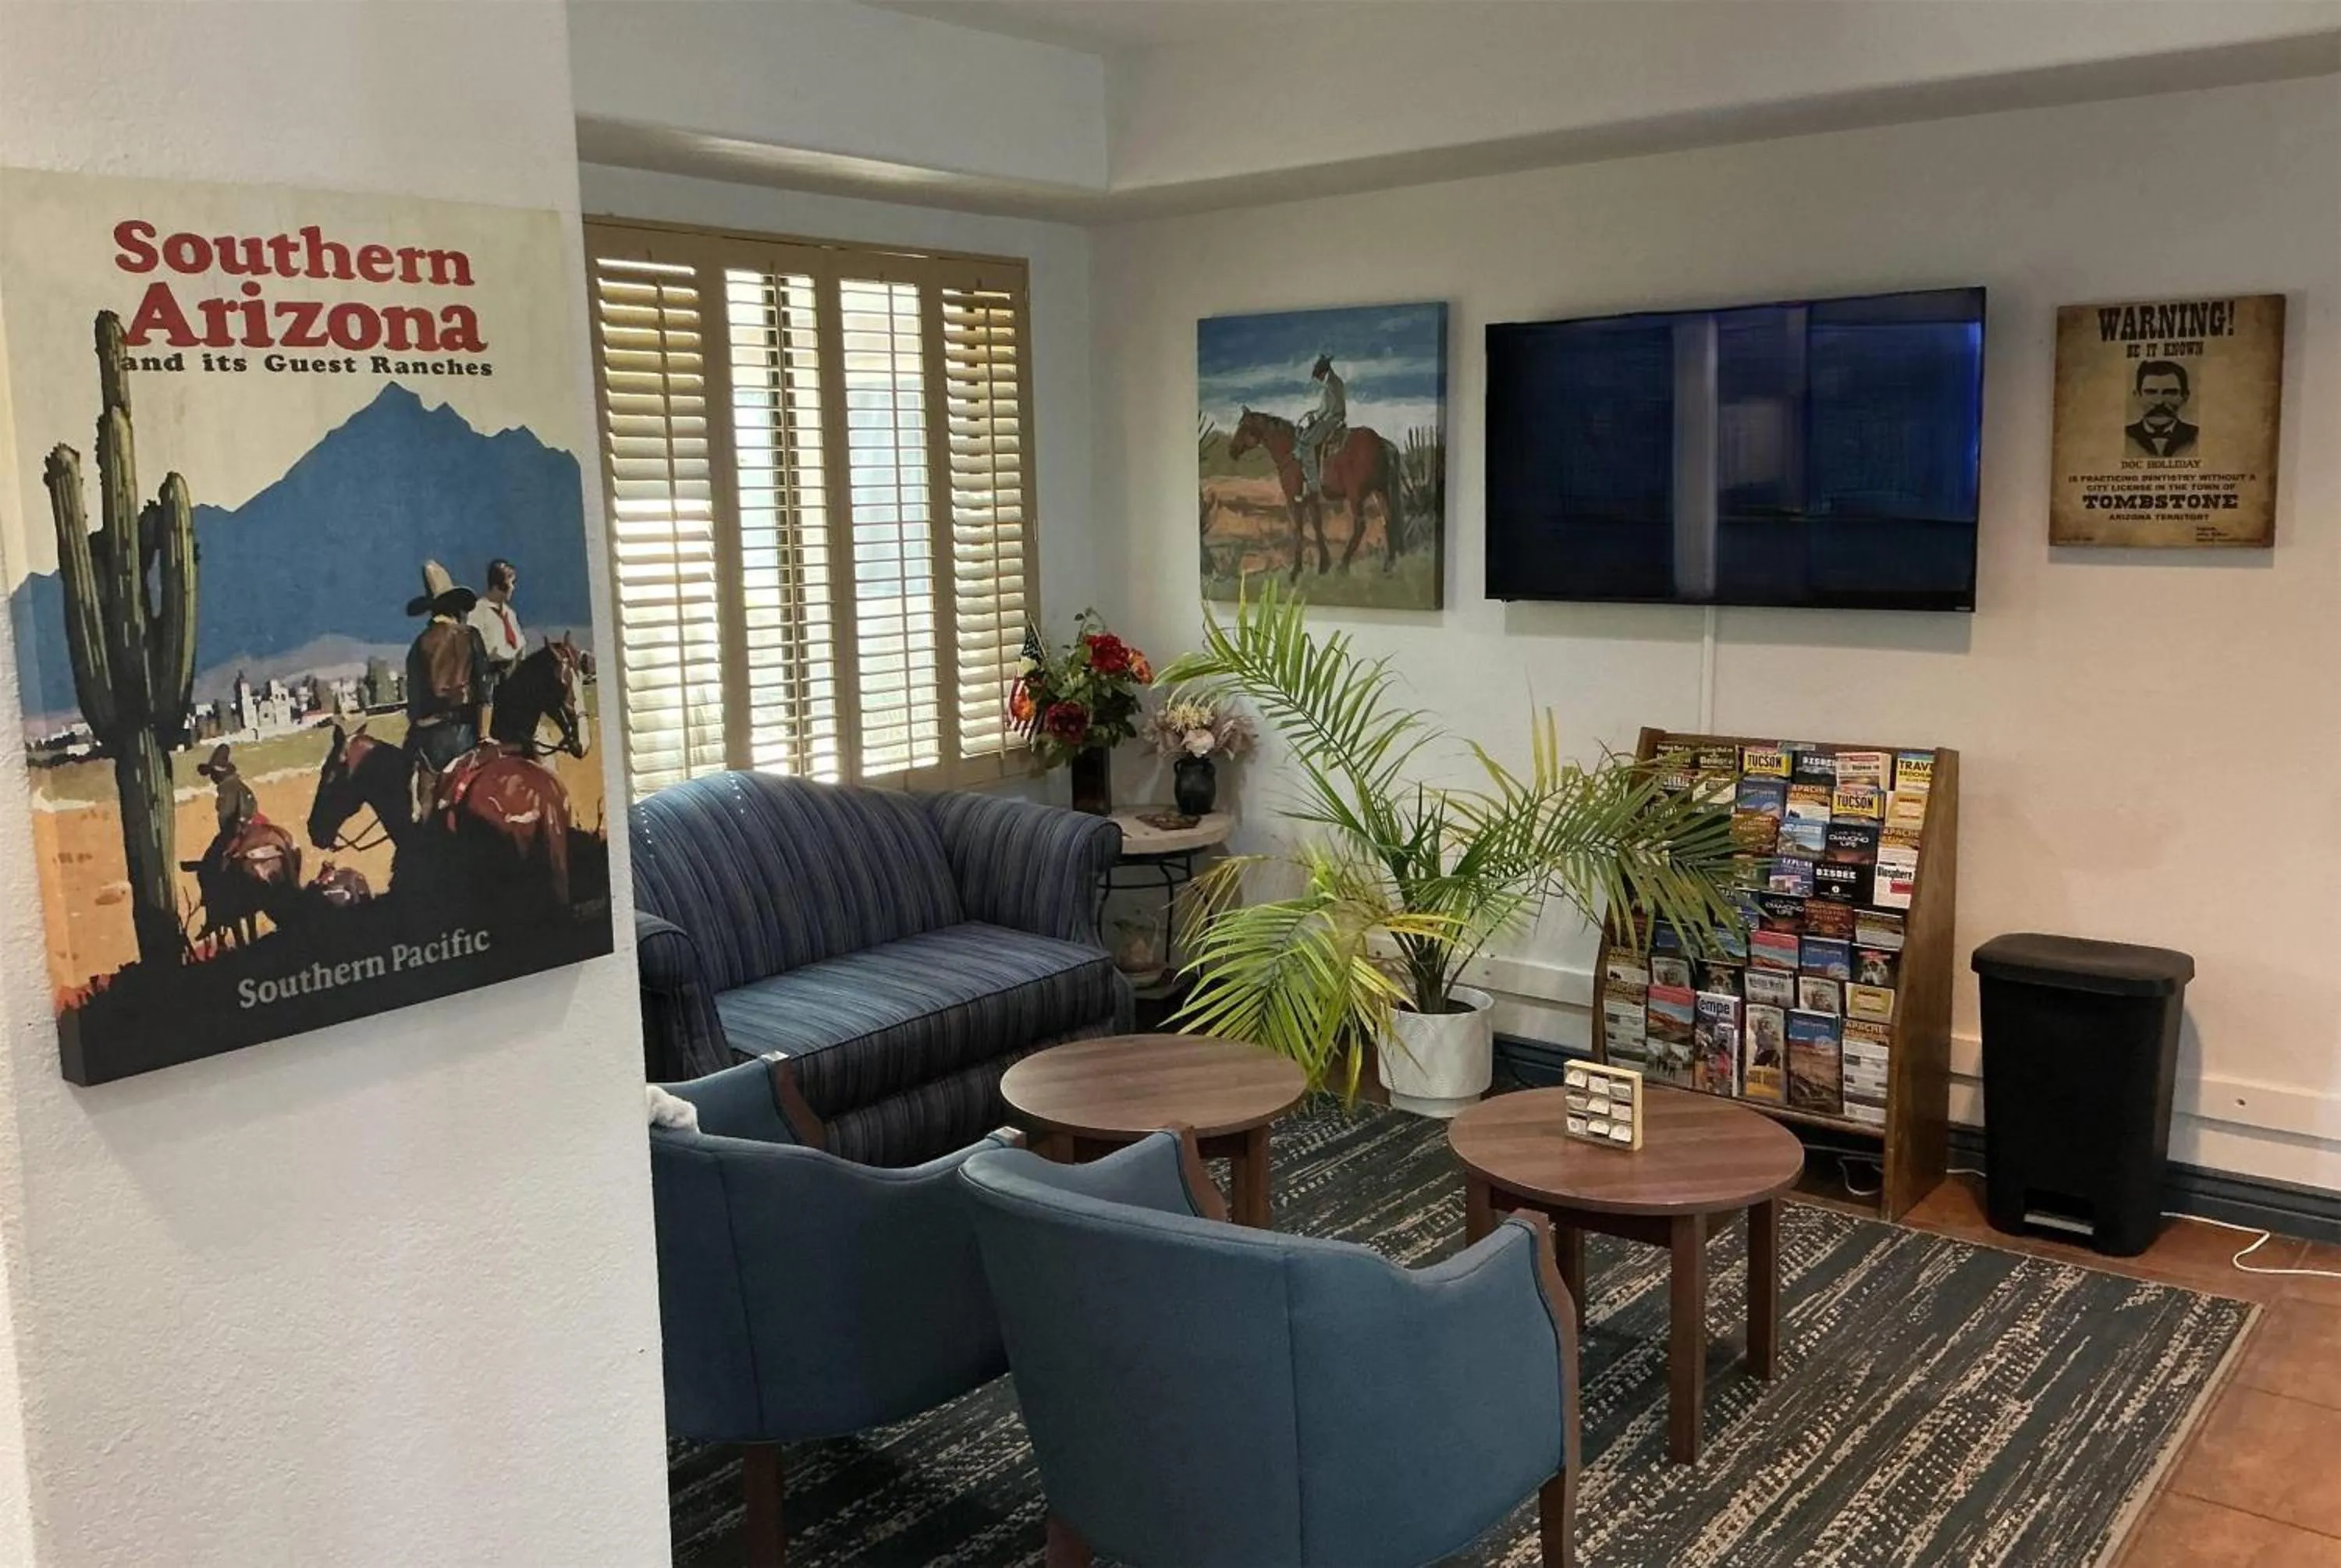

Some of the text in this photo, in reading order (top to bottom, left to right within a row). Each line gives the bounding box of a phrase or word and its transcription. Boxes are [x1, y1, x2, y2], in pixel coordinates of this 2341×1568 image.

[113, 220, 475, 286] Southern
[125, 281, 489, 353] Arizona
[2098, 300, 2235, 342] WARNING!
[2146, 342, 2158, 357] IT
[2164, 341, 2204, 357] KNOWN
[120, 353, 493, 376] and its Guest Ranches
[2121, 460, 2142, 469] DOC
[2083, 493, 2238, 509] TOMBSTONE
[1748, 754, 1782, 768] TUCSON
[1837, 794, 1873, 808] TUCSON
[1829, 835, 1869, 843] DIAMOND
[1816, 868, 1856, 879] BISBEE
[1877, 865, 1913, 880] Biosphere
[238, 928, 492, 1009] Southern Pacific
[1697, 998, 1730, 1015] empe
